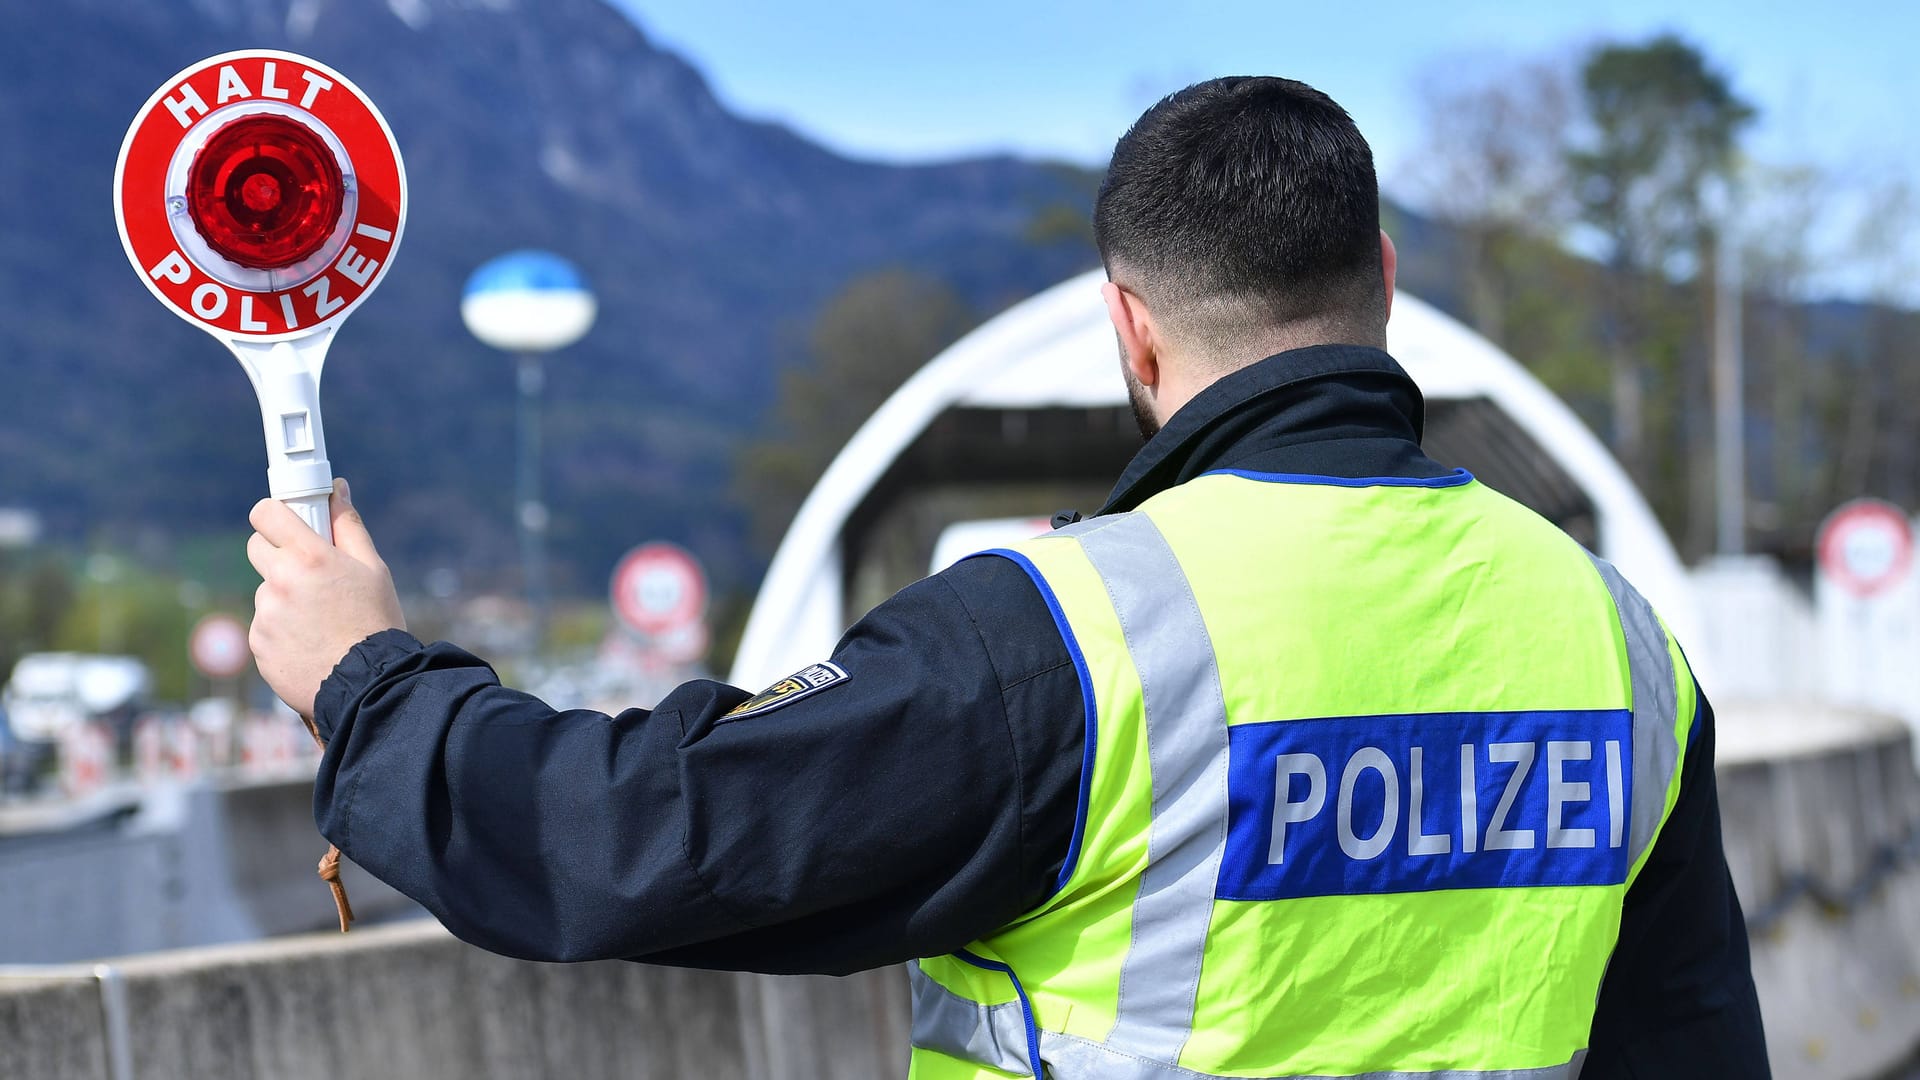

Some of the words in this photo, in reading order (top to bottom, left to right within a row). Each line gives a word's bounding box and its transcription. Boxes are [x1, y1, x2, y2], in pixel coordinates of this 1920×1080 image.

[162, 62, 333, 129] HALT
[149, 223, 392, 331] POLIZEI
[1267, 740, 1624, 865] POLIZEI
